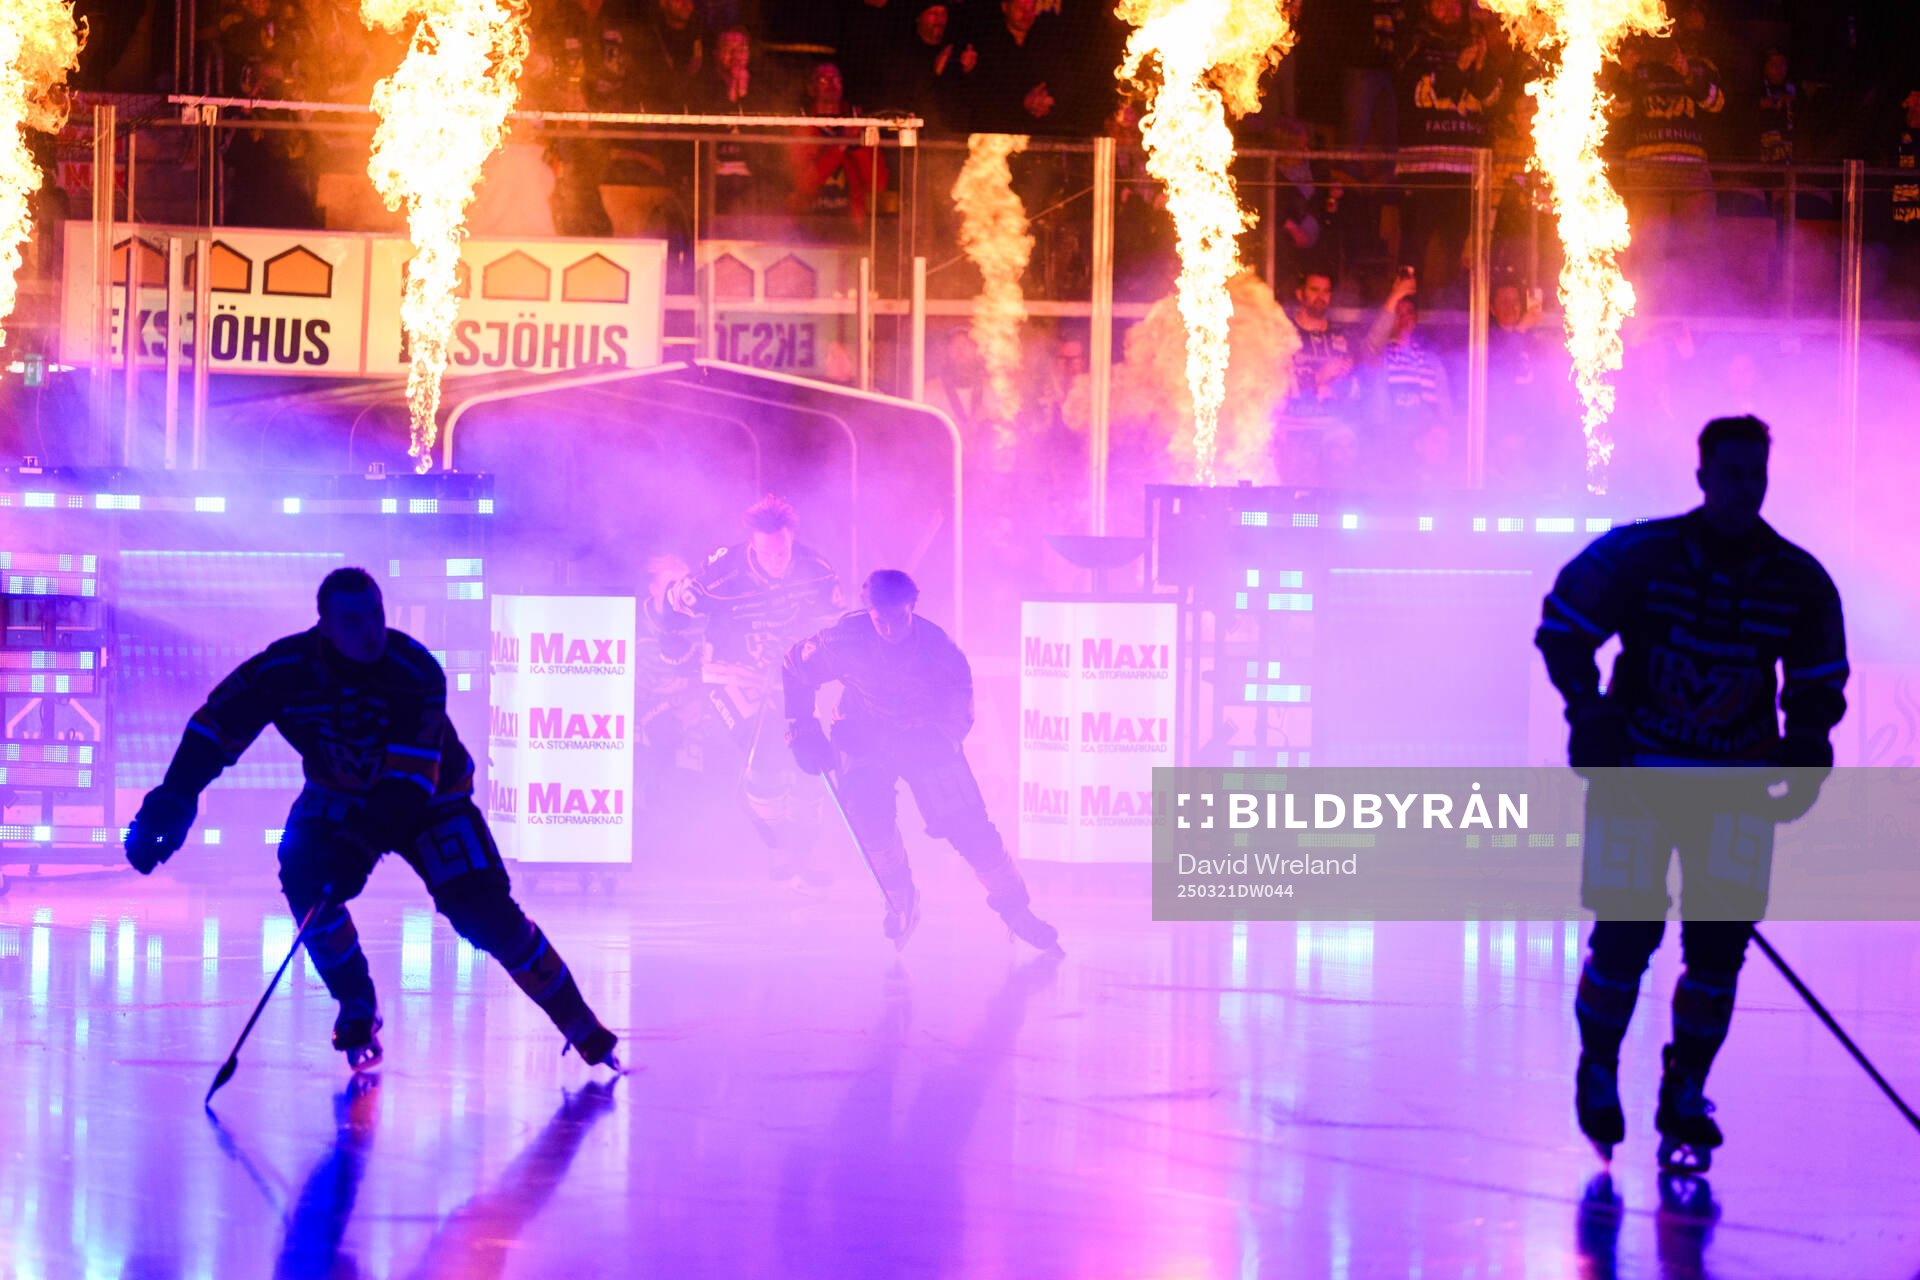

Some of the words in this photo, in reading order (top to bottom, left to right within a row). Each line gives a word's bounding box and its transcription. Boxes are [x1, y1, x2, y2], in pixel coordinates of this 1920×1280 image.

[399, 312, 629, 368] SJÖHUS
[531, 633, 626, 664] MAXI
[1082, 638, 1168, 669] MAXI
[530, 666, 545, 674] ICA
[548, 666, 625, 675] STORMARKNAD
[529, 707, 625, 739] MAXI
[1081, 712, 1168, 742] MAXI
[529, 741, 544, 749] ICA
[546, 741, 624, 750] STORMARKNAD
[528, 783, 623, 814] MAXI
[1081, 785, 1166, 816] MAXI
[528, 816, 543, 824] ICA
[546, 816, 623, 824] STORMARKNAD
